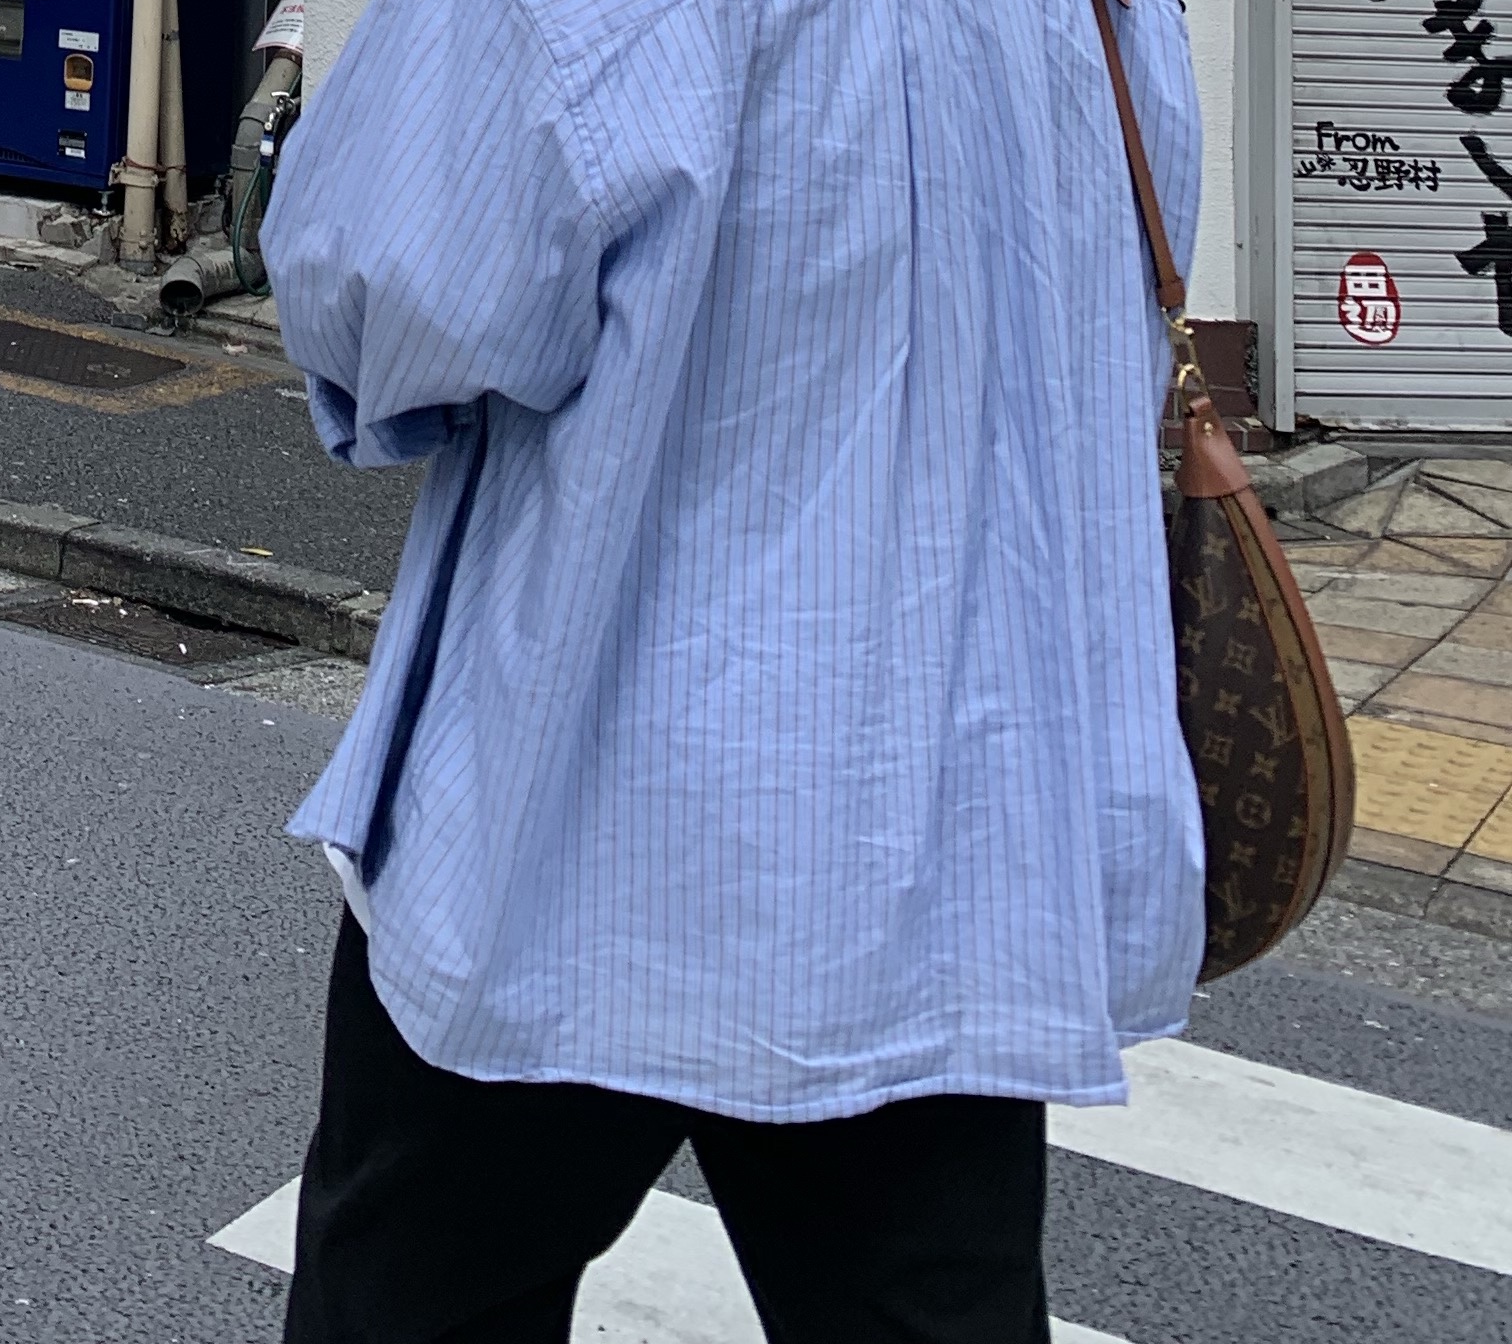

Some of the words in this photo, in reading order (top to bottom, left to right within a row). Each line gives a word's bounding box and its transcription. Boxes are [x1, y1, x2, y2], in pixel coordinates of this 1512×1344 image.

[1316, 121, 1400, 152] From
[1338, 156, 1441, 192] 忍野村
